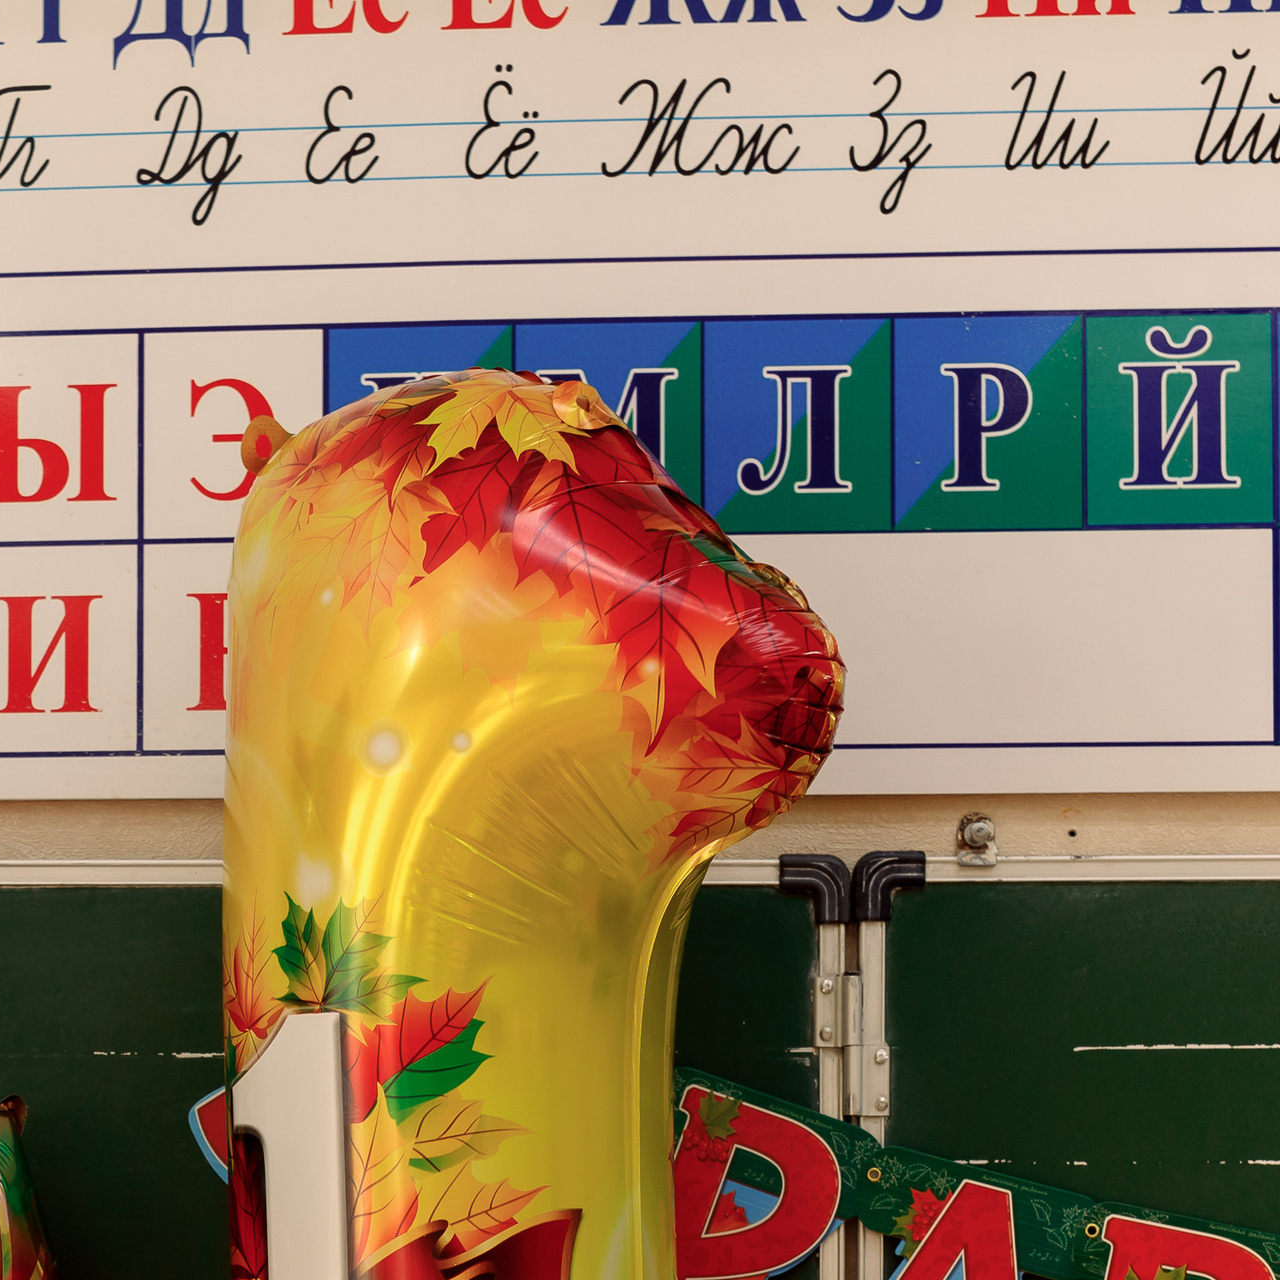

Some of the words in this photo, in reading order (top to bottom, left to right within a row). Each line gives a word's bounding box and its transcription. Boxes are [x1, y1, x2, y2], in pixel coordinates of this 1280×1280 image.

[306, 85, 379, 185] Ее
[601, 77, 801, 178] Жж
[849, 68, 933, 215] Зз
[189, 377, 276, 502] Э
[735, 364, 853, 496] Л
[937, 360, 1035, 495] Р
[1117, 323, 1242, 491] Й
